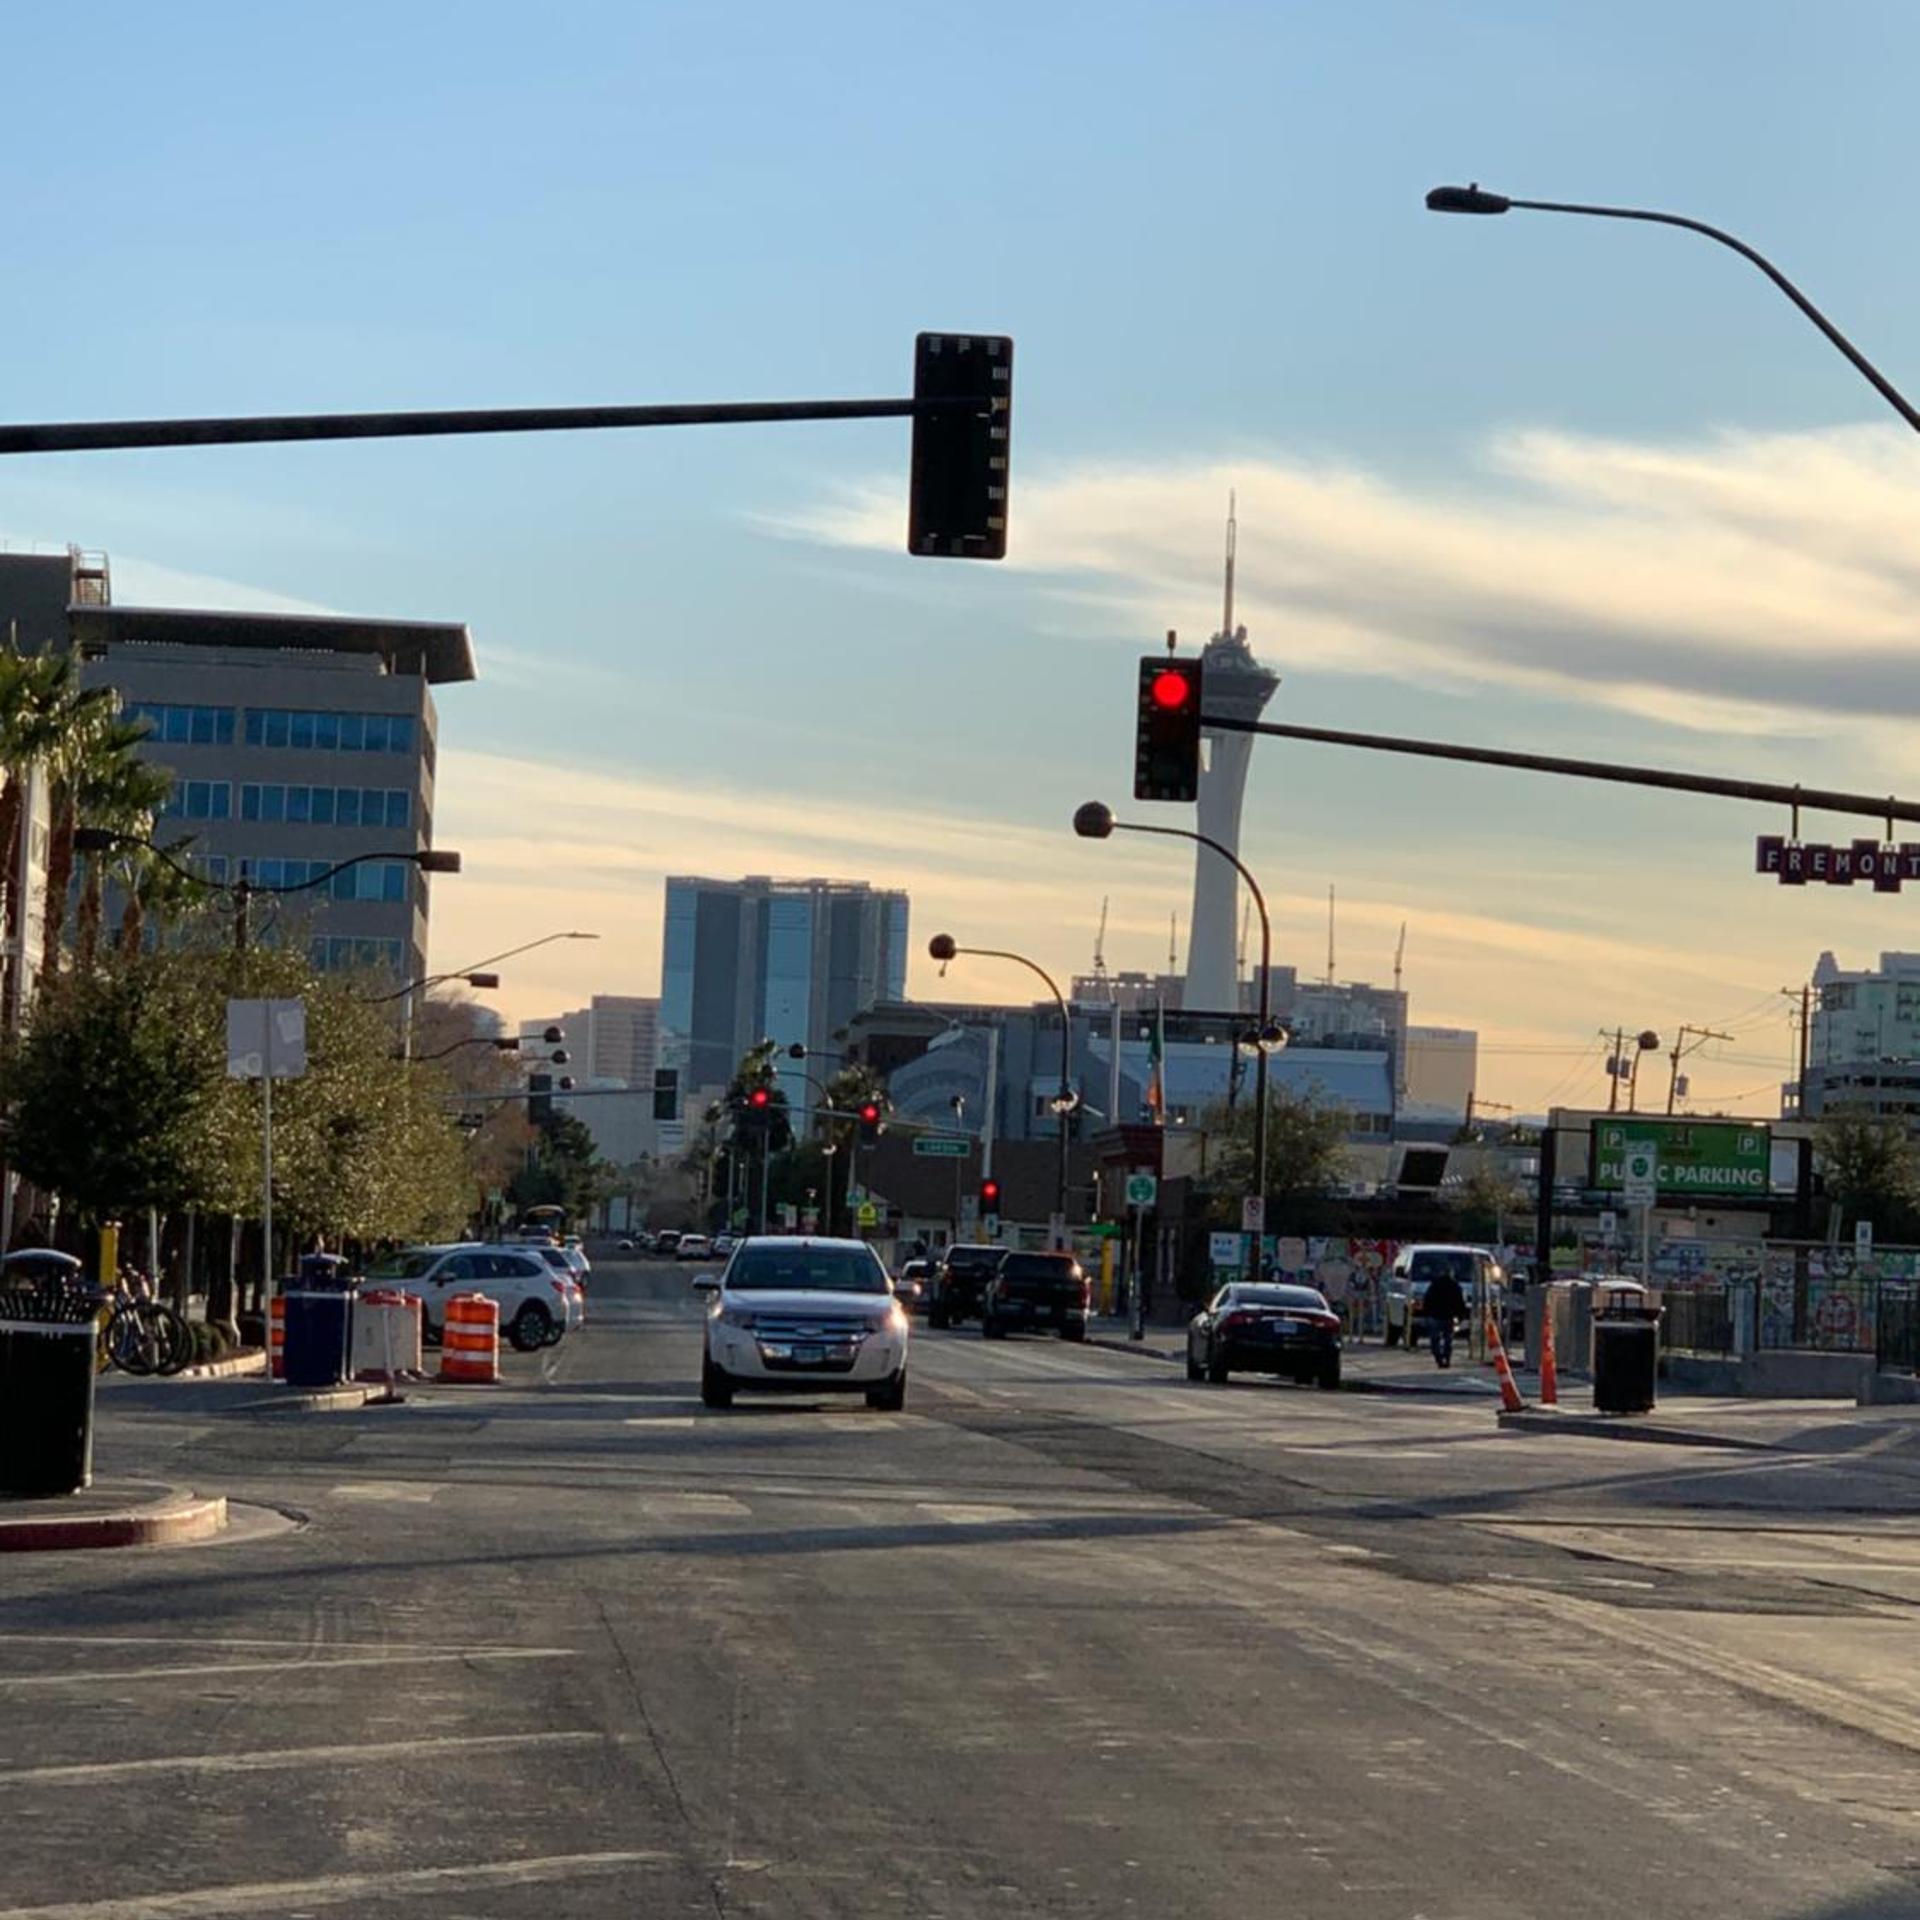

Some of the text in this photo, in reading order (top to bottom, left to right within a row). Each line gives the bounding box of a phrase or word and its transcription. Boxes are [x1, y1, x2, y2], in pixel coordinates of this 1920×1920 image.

[1765, 850, 1920, 877] FREMONT
[1743, 1138, 1755, 1153] P
[1600, 1163, 1763, 1185] PUC PARKING
